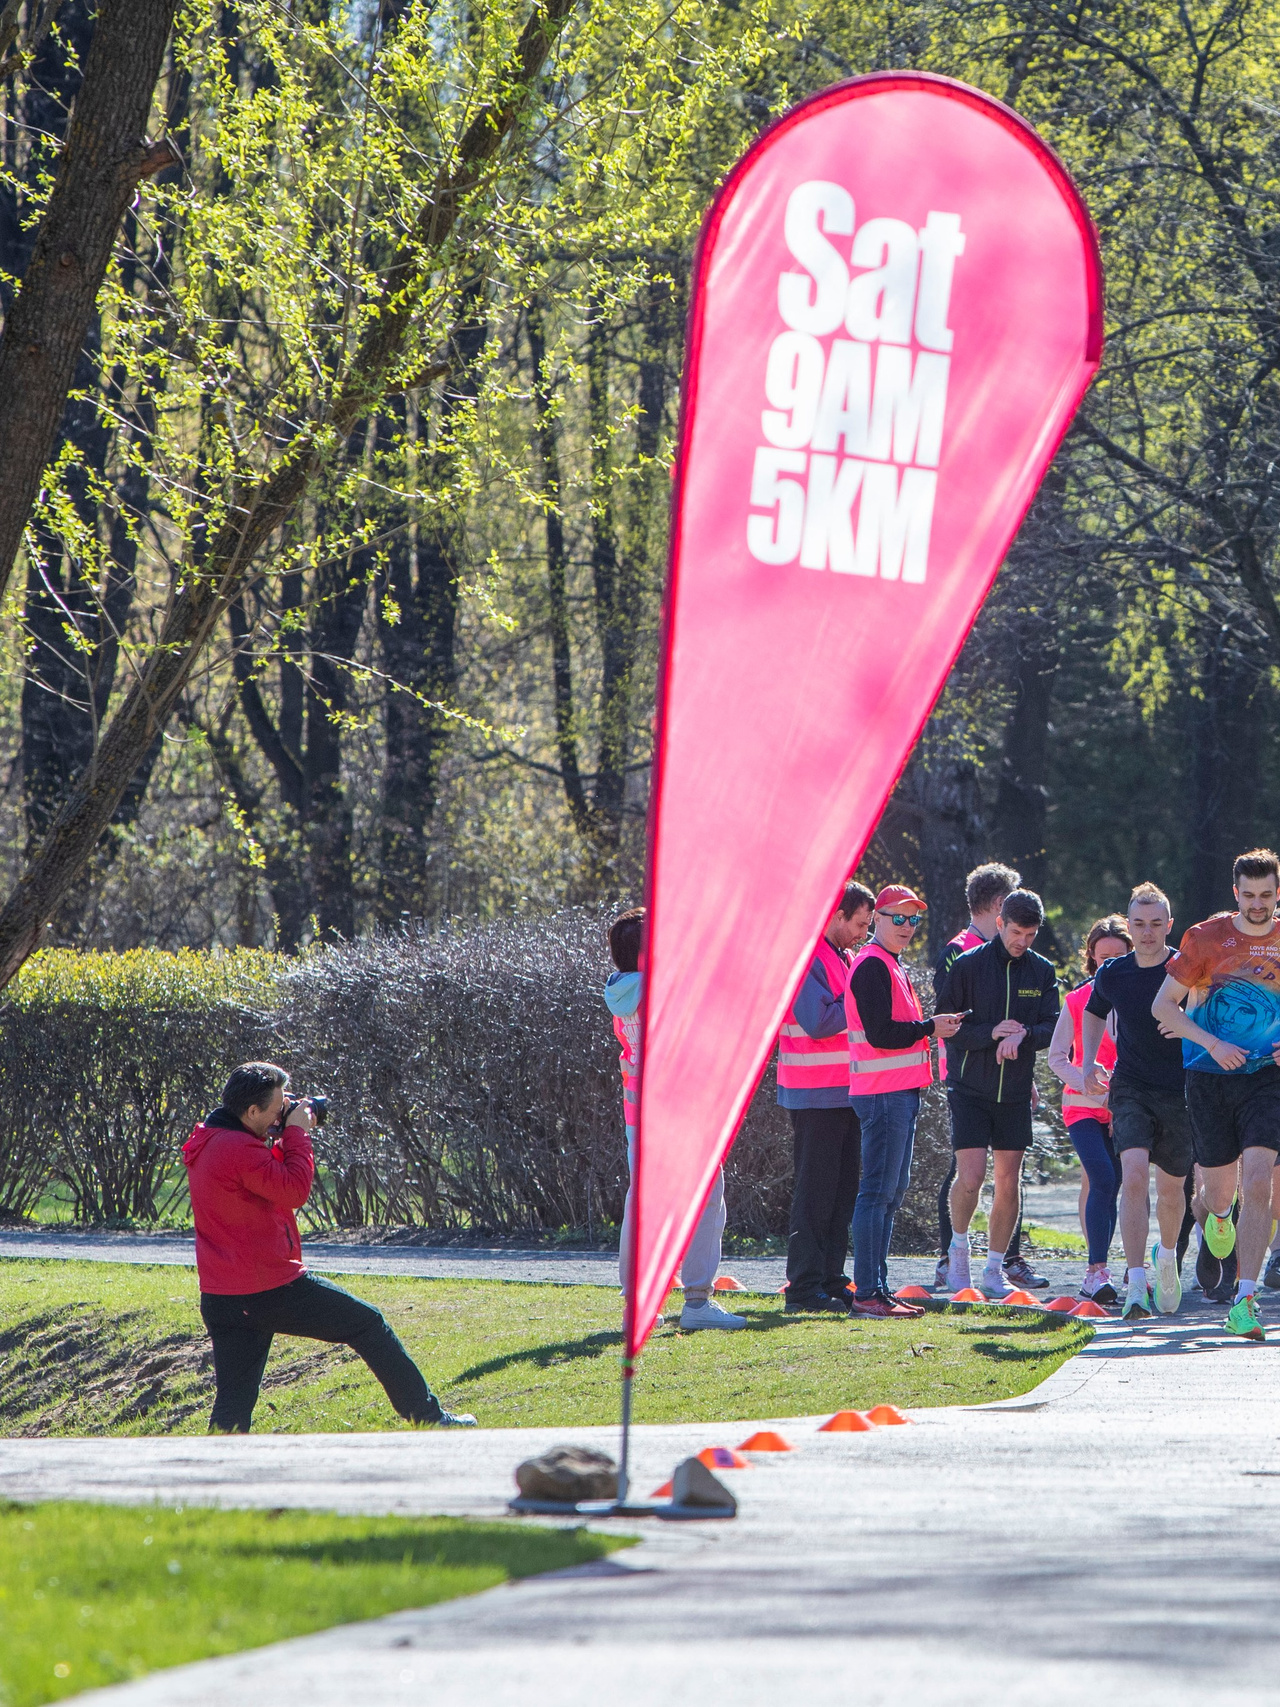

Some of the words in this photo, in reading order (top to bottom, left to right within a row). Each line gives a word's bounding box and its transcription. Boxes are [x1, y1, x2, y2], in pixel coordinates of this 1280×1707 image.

[777, 180, 966, 352] Sat
[761, 330, 951, 467] 9AM
[746, 446, 938, 584] 5KM
